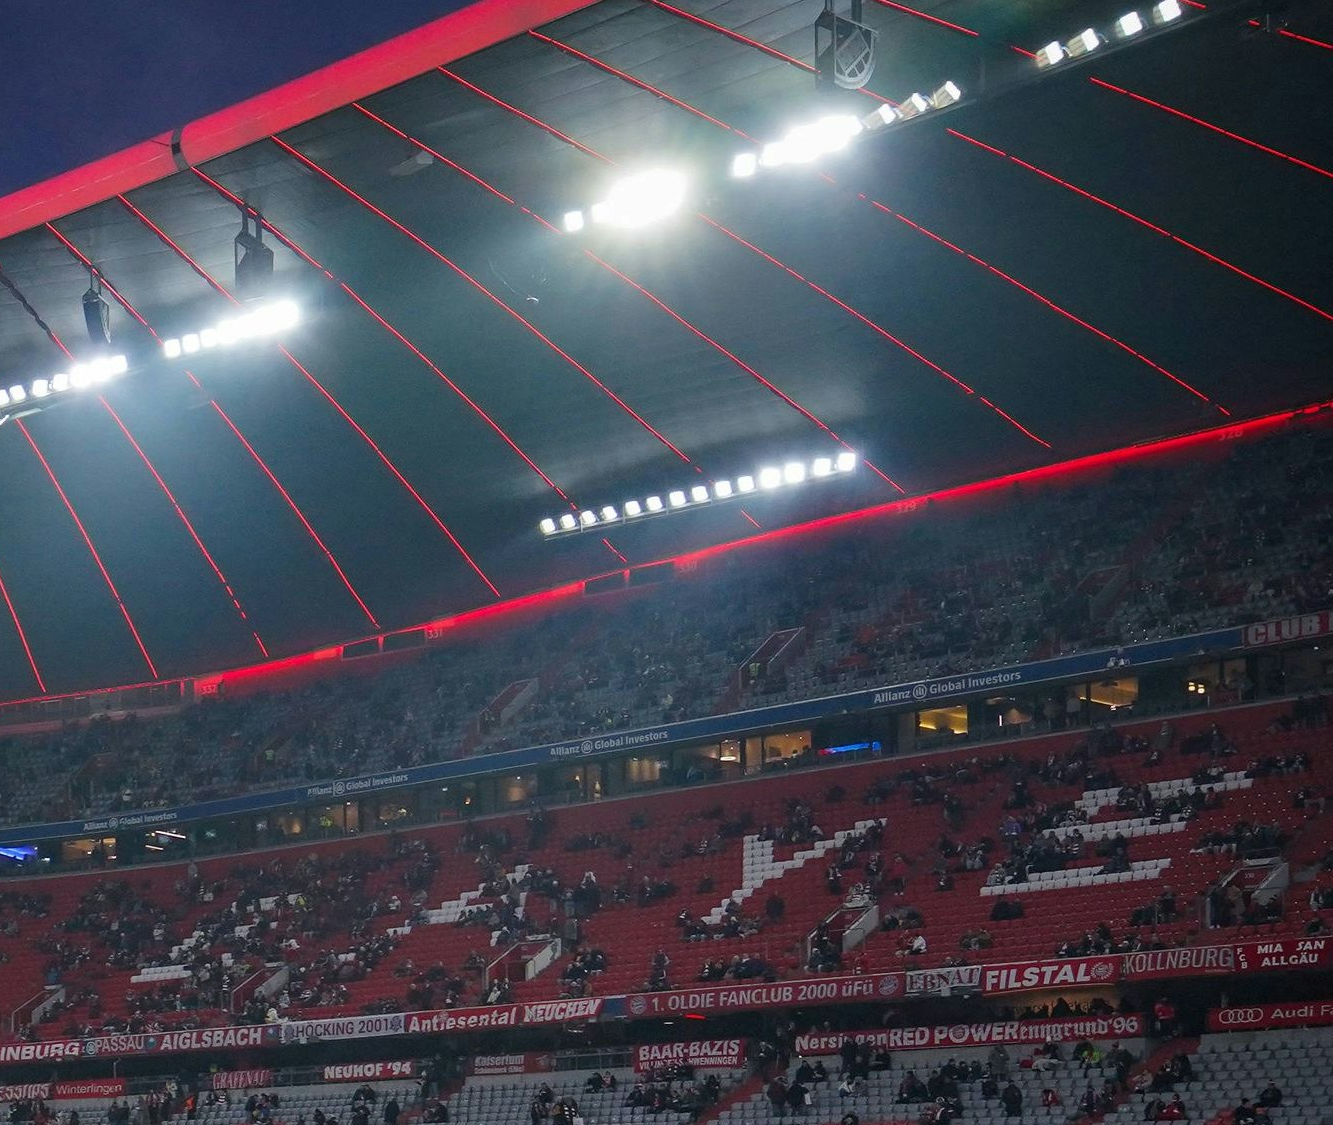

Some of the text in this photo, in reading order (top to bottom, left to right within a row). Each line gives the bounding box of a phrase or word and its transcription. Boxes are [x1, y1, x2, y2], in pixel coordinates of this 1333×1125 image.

[1247, 615, 1321, 645] CLUB
[873, 670, 1022, 705] Allianz Global Investors
[550, 729, 669, 756] Allianz Global Investors
[345, 780, 371, 792] Global
[372, 773, 409, 787] Investors
[1257, 940, 1326, 955] MIA SAN
[1261, 953, 1319, 967] ALLGÄU
[986, 963, 1092, 991] FILSTAL
[651, 996, 665, 1012] 1.
[668, 992, 715, 1010] OLDIE
[719, 986, 793, 1007] FANCLUB
[797, 983, 837, 1001] 2000
[1271, 1005, 1314, 1019] Audi
[160, 1027, 263, 1051] AIGLSBACH
[296, 1017, 390, 1039] HÖCKING 2001
[887, 1021, 1021, 1047] RED POWER
[94, 1035, 145, 1052] PASSAU
[638, 1039, 741, 1061] BAAR-BAZIS
[323, 1063, 383, 1080] NEUHOF
[55, 1078, 123, 1096] Winterlingen
